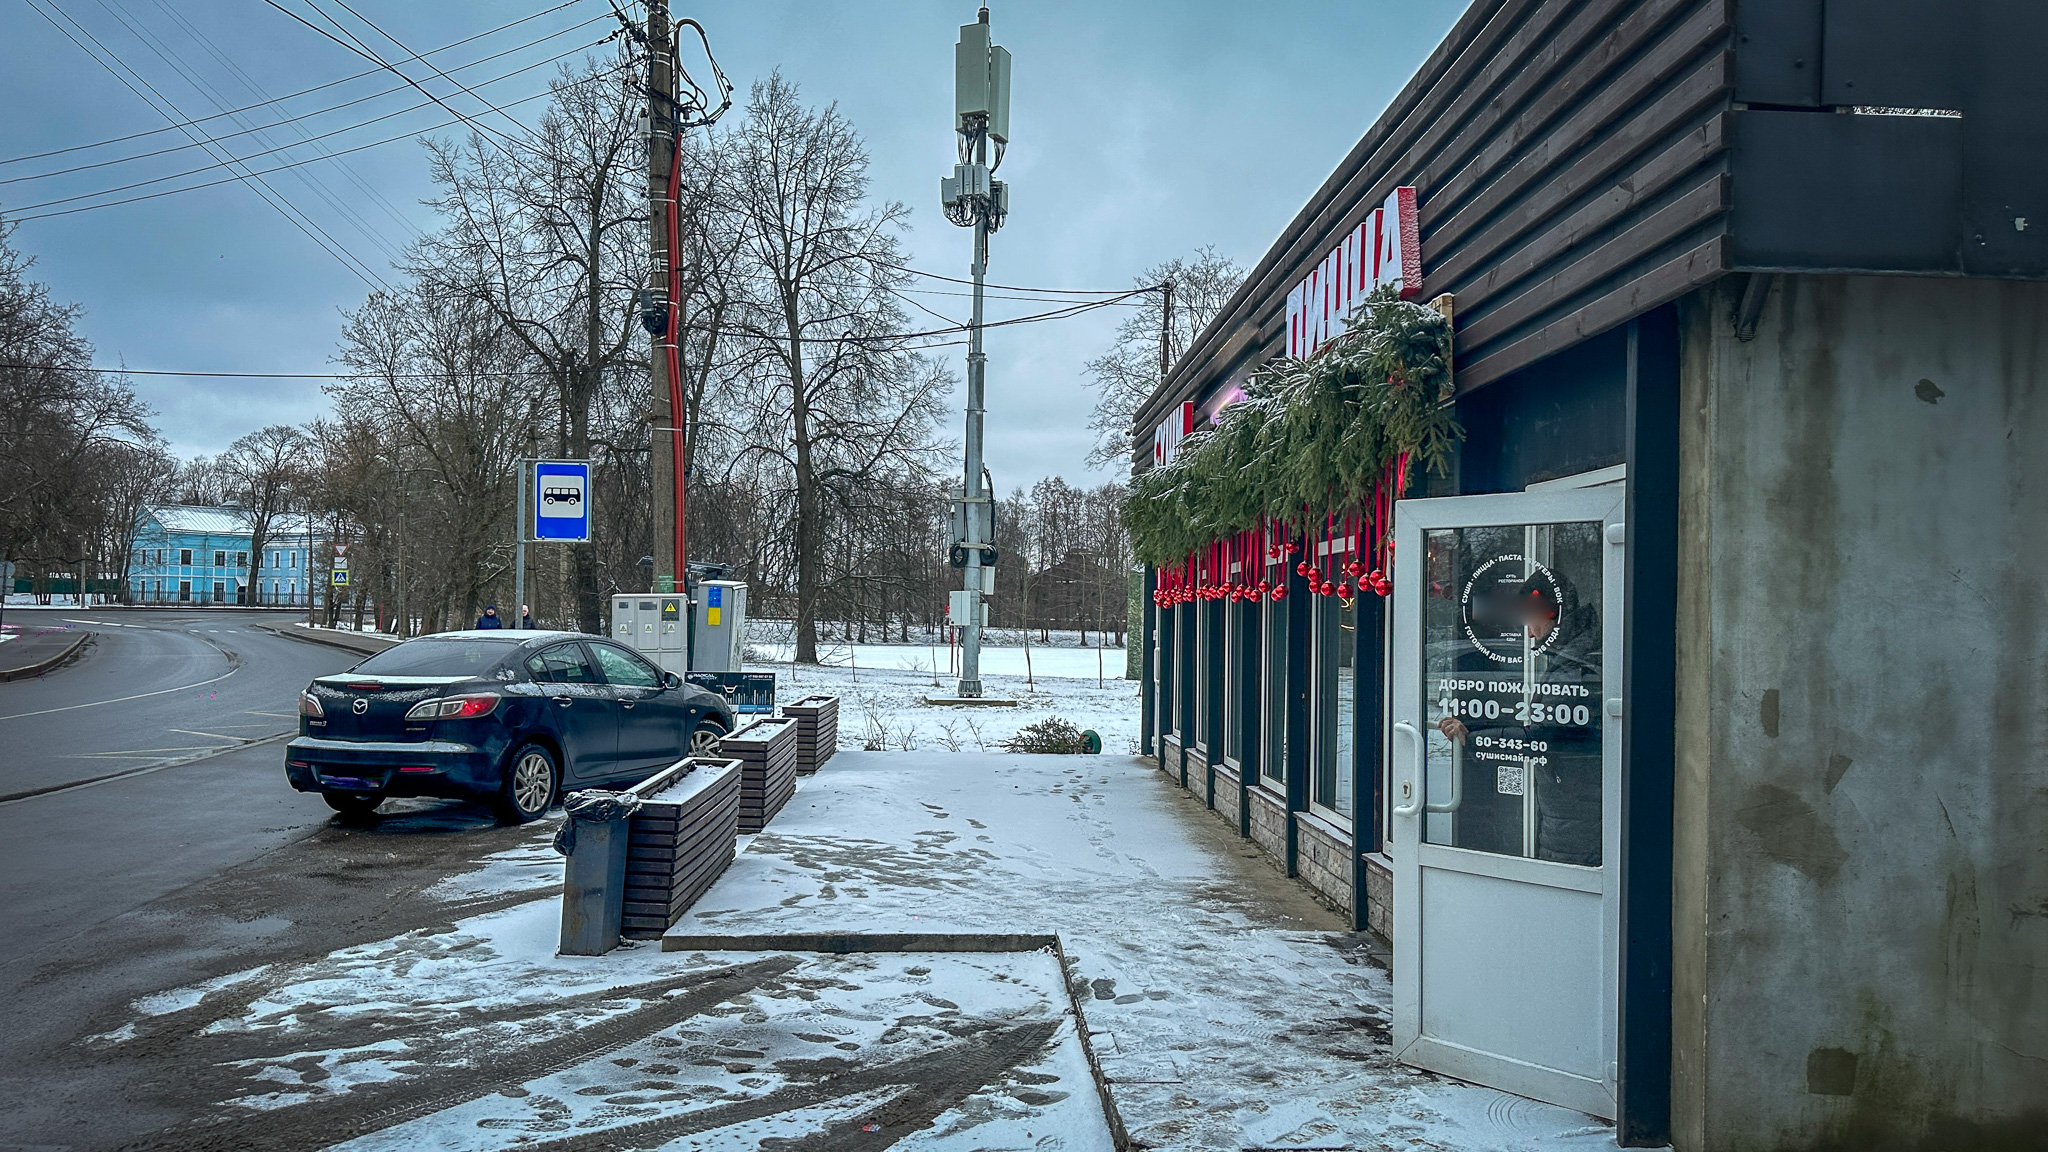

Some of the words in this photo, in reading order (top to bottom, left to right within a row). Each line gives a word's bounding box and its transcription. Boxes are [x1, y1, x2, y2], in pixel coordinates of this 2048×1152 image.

[1286, 186, 1420, 362] ПИЦЦА
[1461, 582, 1474, 604] СУШИ
[1473, 559, 1496, 579] ПИЦЦА
[1498, 554, 1522, 562] ПАСТА
[1553, 586, 1564, 604] ВОК
[1464, 625, 1490, 657] ГОТОВИМ
[1489, 652, 1506, 663] ДЛЯ
[1507, 656, 1523, 664] ВАС
[1545, 627, 1561, 647] ГОДА
[1439, 679, 1485, 692] ДОБРО
[1488, 681, 1590, 697] ПОЖАЛОВАТЬ
[1438, 697, 1590, 726] 11:00-23:00
[1475, 736, 1548, 752] 60-343-60
[1475, 751, 1548, 766] сушисмайл.рф
